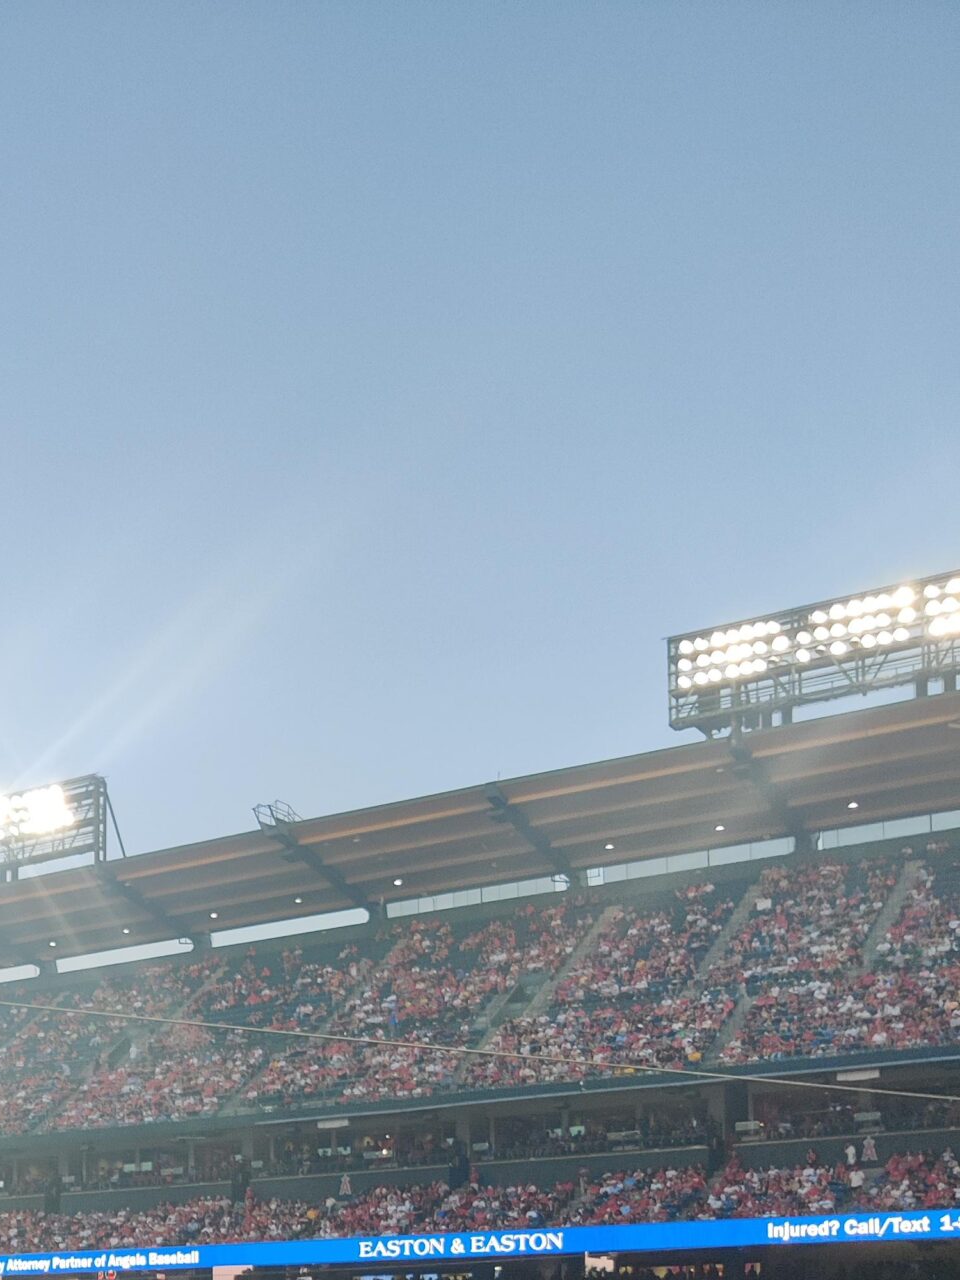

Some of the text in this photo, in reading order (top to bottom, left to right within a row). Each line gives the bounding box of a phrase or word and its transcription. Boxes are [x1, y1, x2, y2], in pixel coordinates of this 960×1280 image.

[767, 1215, 960, 1241] Injured? Call/Text 1-
[359, 1232, 563, 1257] EASTON & EASTON
[7, 1258, 50, 1272] Attorney
[52, 1256, 92, 1269] Partner
[94, 1255, 106, 1268] of
[149, 1251, 199, 1265] Baseball
